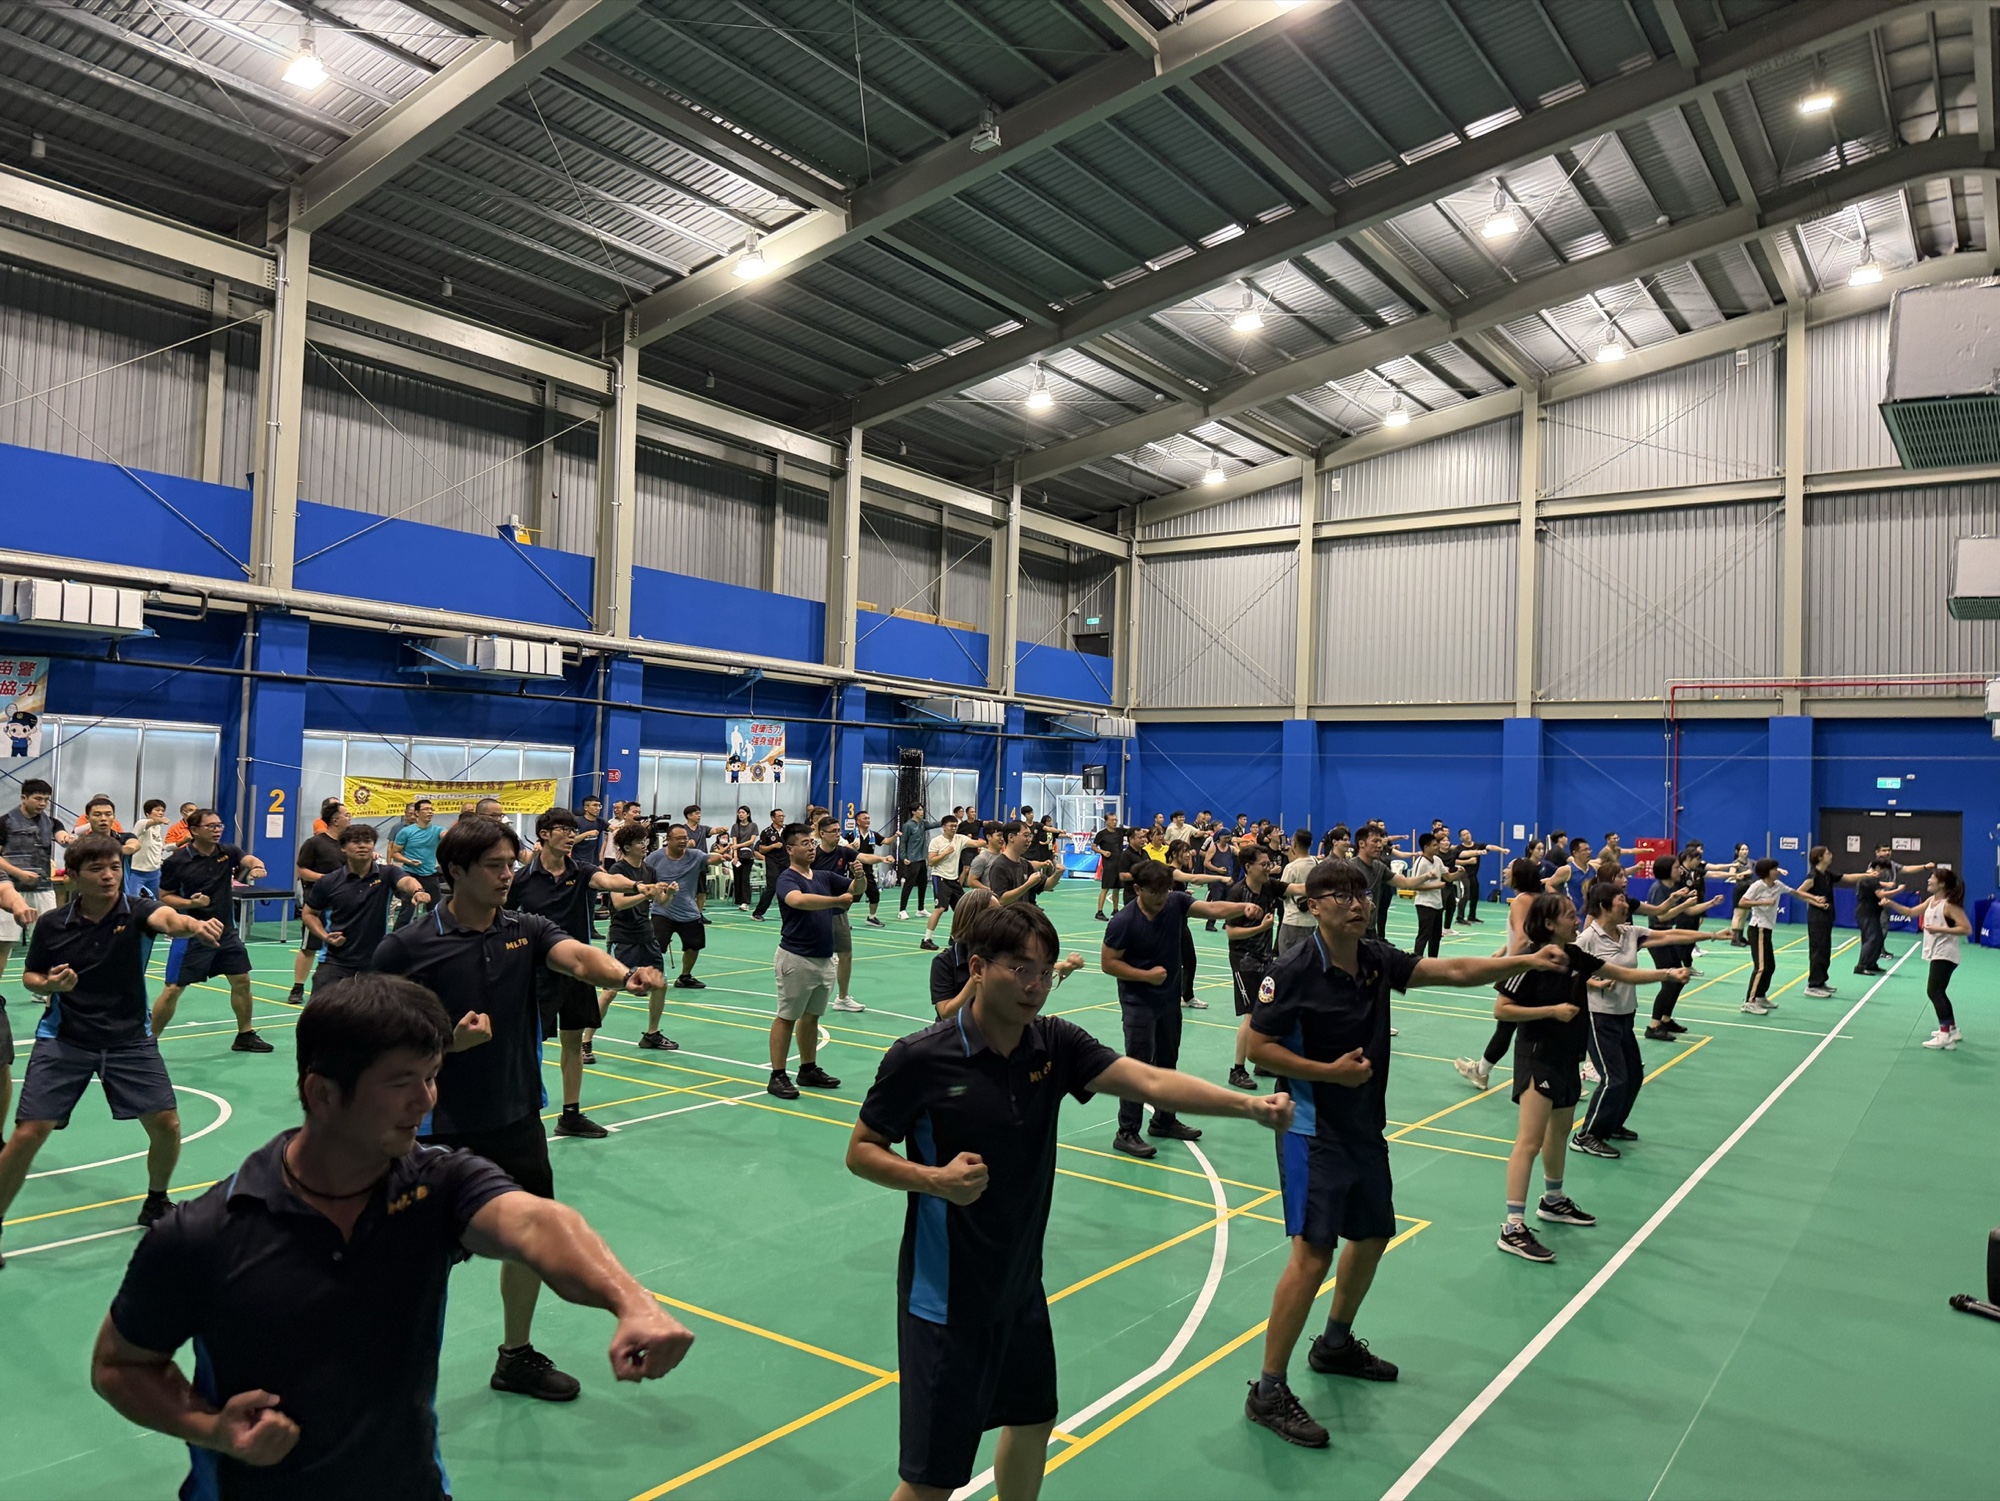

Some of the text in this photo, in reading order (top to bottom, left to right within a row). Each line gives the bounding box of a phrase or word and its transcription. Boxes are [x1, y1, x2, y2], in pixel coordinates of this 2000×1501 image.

[0, 660, 38, 677] 苗警
[0, 680, 38, 697] 協力
[751, 723, 782, 734] 健康活力
[750, 736, 783, 746] 強身健體
[269, 789, 285, 812] 2
[847, 802, 854, 819] 3
[1010, 806, 1017, 820] 4
[1889, 914, 1912, 922] SUPA
[505, 937, 529, 950] MLFB
